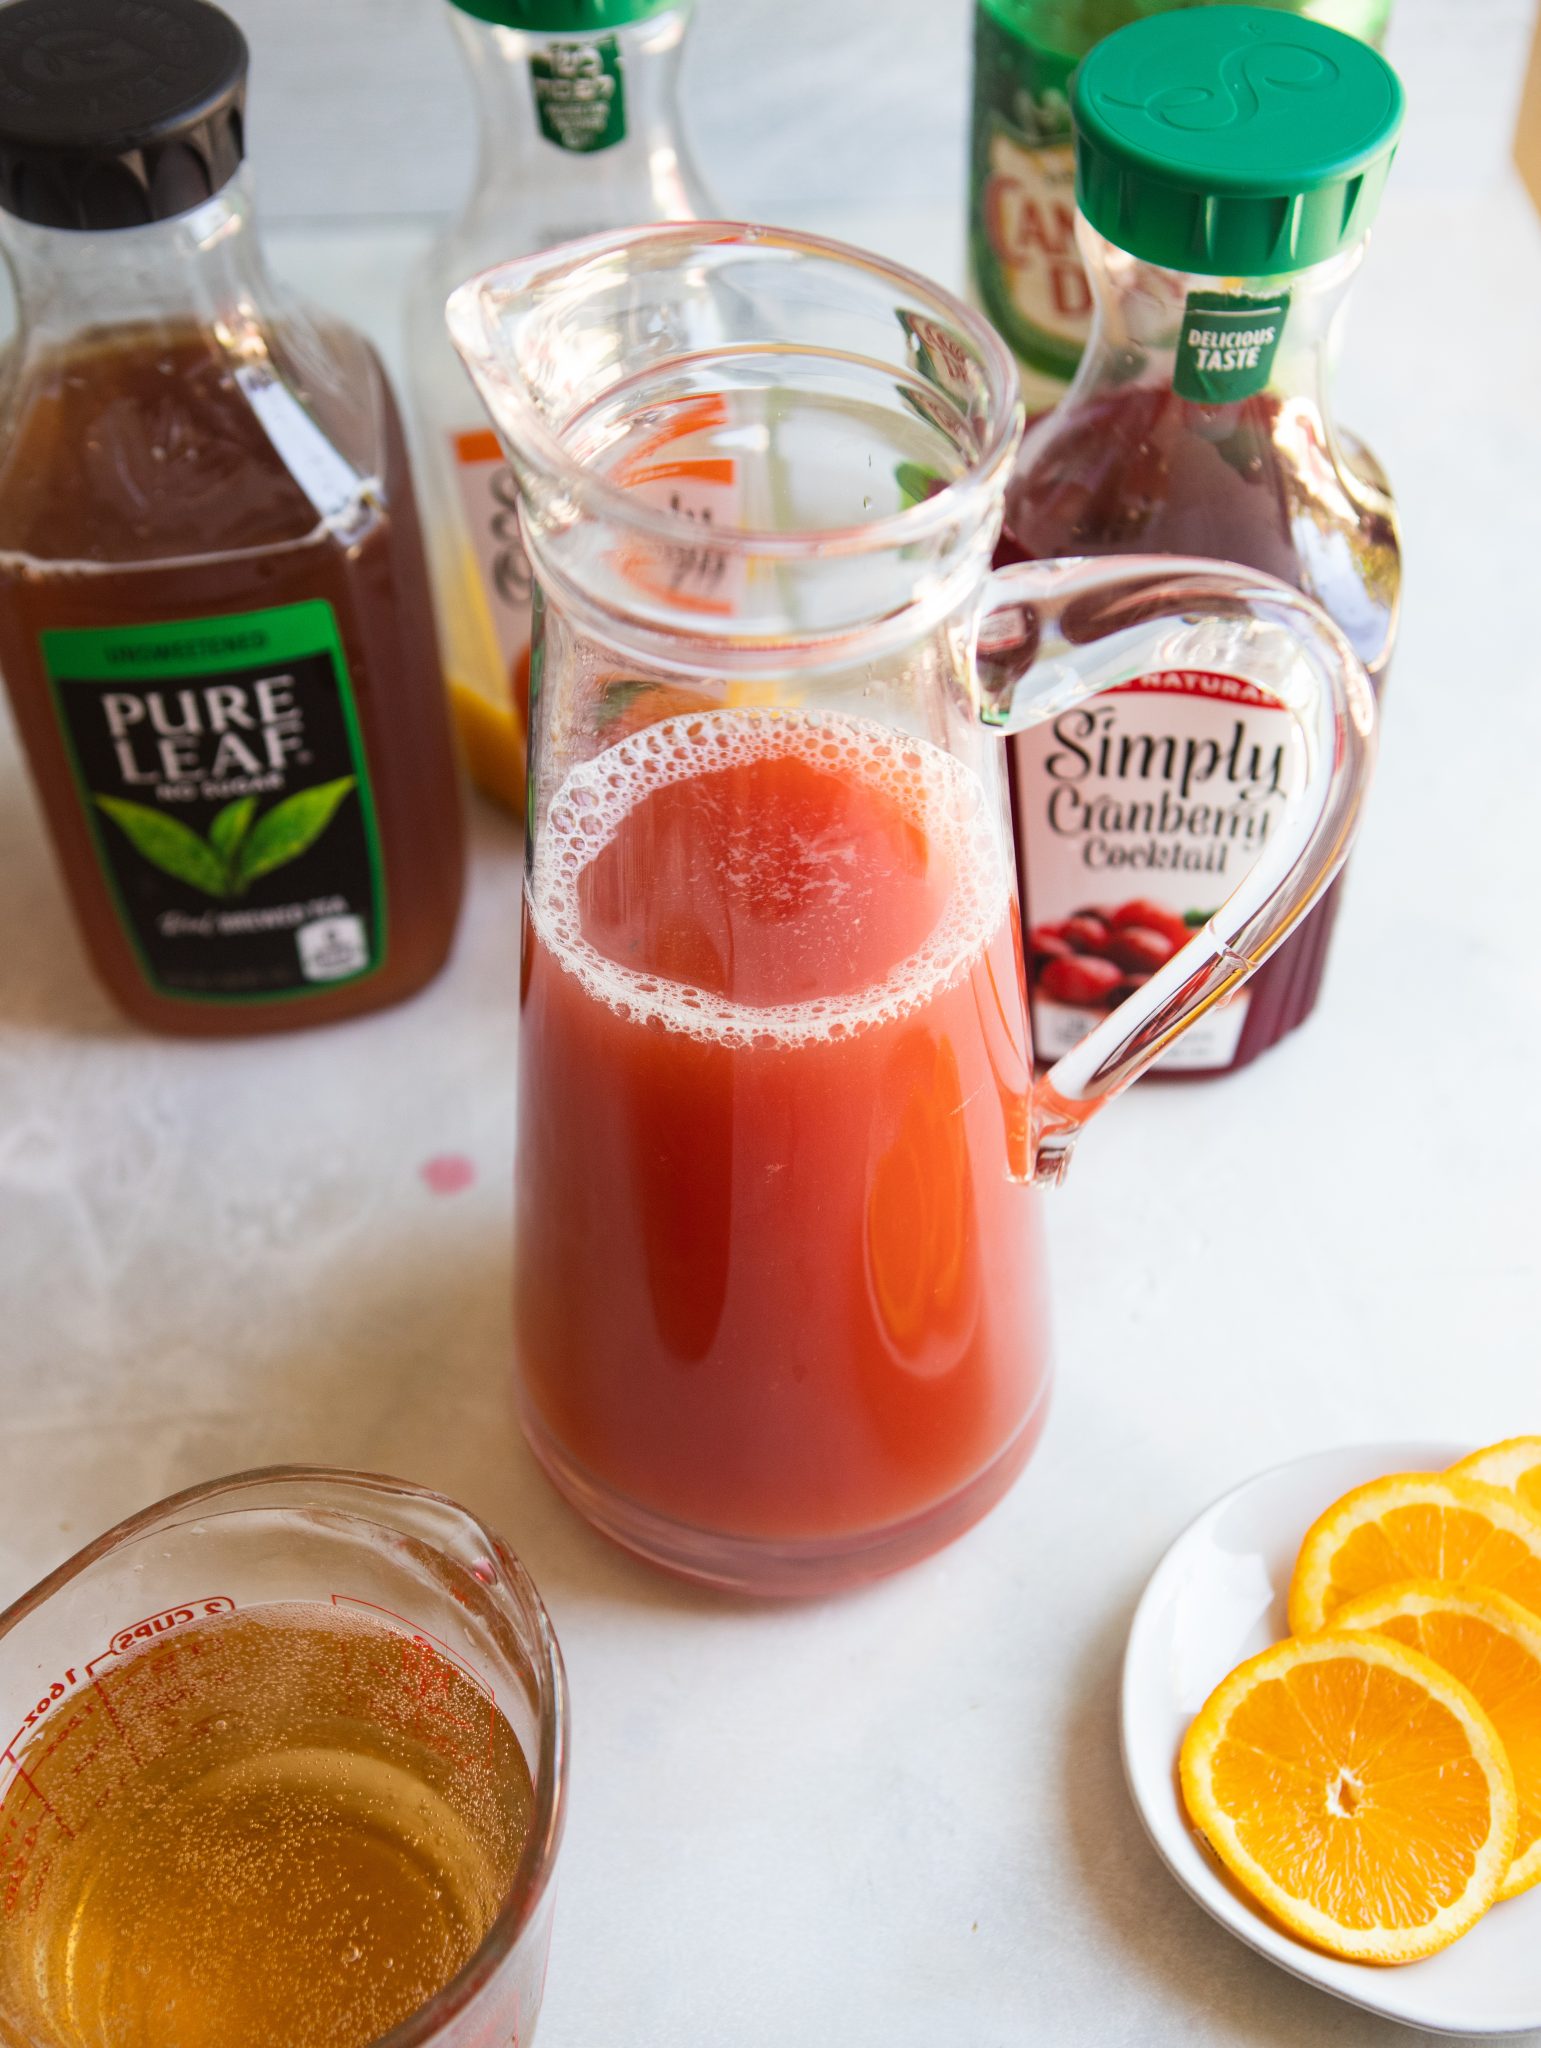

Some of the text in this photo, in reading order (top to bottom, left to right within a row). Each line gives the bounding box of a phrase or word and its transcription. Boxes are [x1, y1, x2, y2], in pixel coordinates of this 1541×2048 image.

[1188, 326, 1276, 349] DELICIOUS
[1196, 346, 1261, 371] TASTE
[104, 632, 269, 664] UNSWEETENED
[103, 675, 302, 738] PURE
[115, 719, 304, 784] LEAF
[1045, 706, 1287, 799] Simply
[1047, 783, 1269, 850] Cranberry
[1083, 836, 1228, 874] Cocktail
